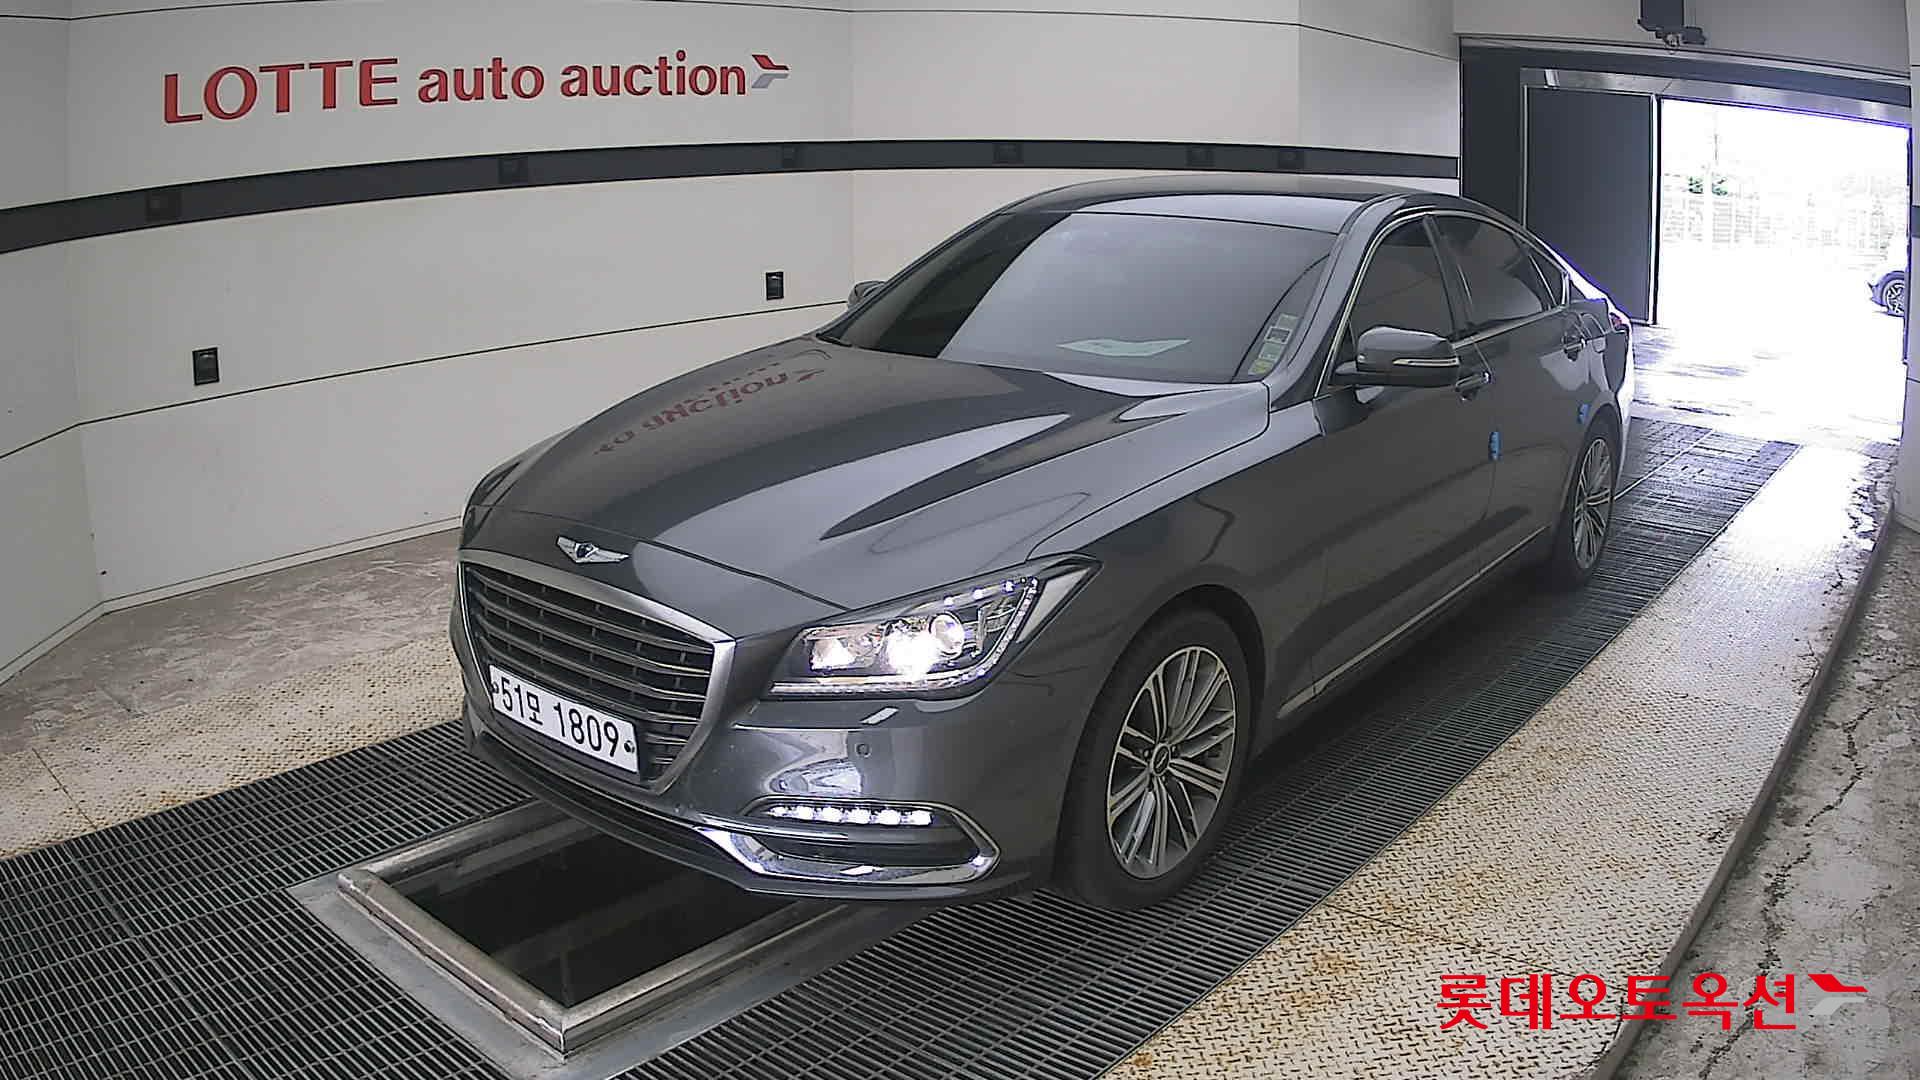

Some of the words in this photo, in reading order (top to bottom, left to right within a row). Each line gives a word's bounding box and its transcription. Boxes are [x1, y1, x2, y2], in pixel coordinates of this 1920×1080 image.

[164, 57, 399, 123] LOTTE
[418, 56, 545, 103] auto
[560, 49, 747, 97] auction
[501, 676, 544, 726] 51모
[553, 702, 620, 758] 1809
